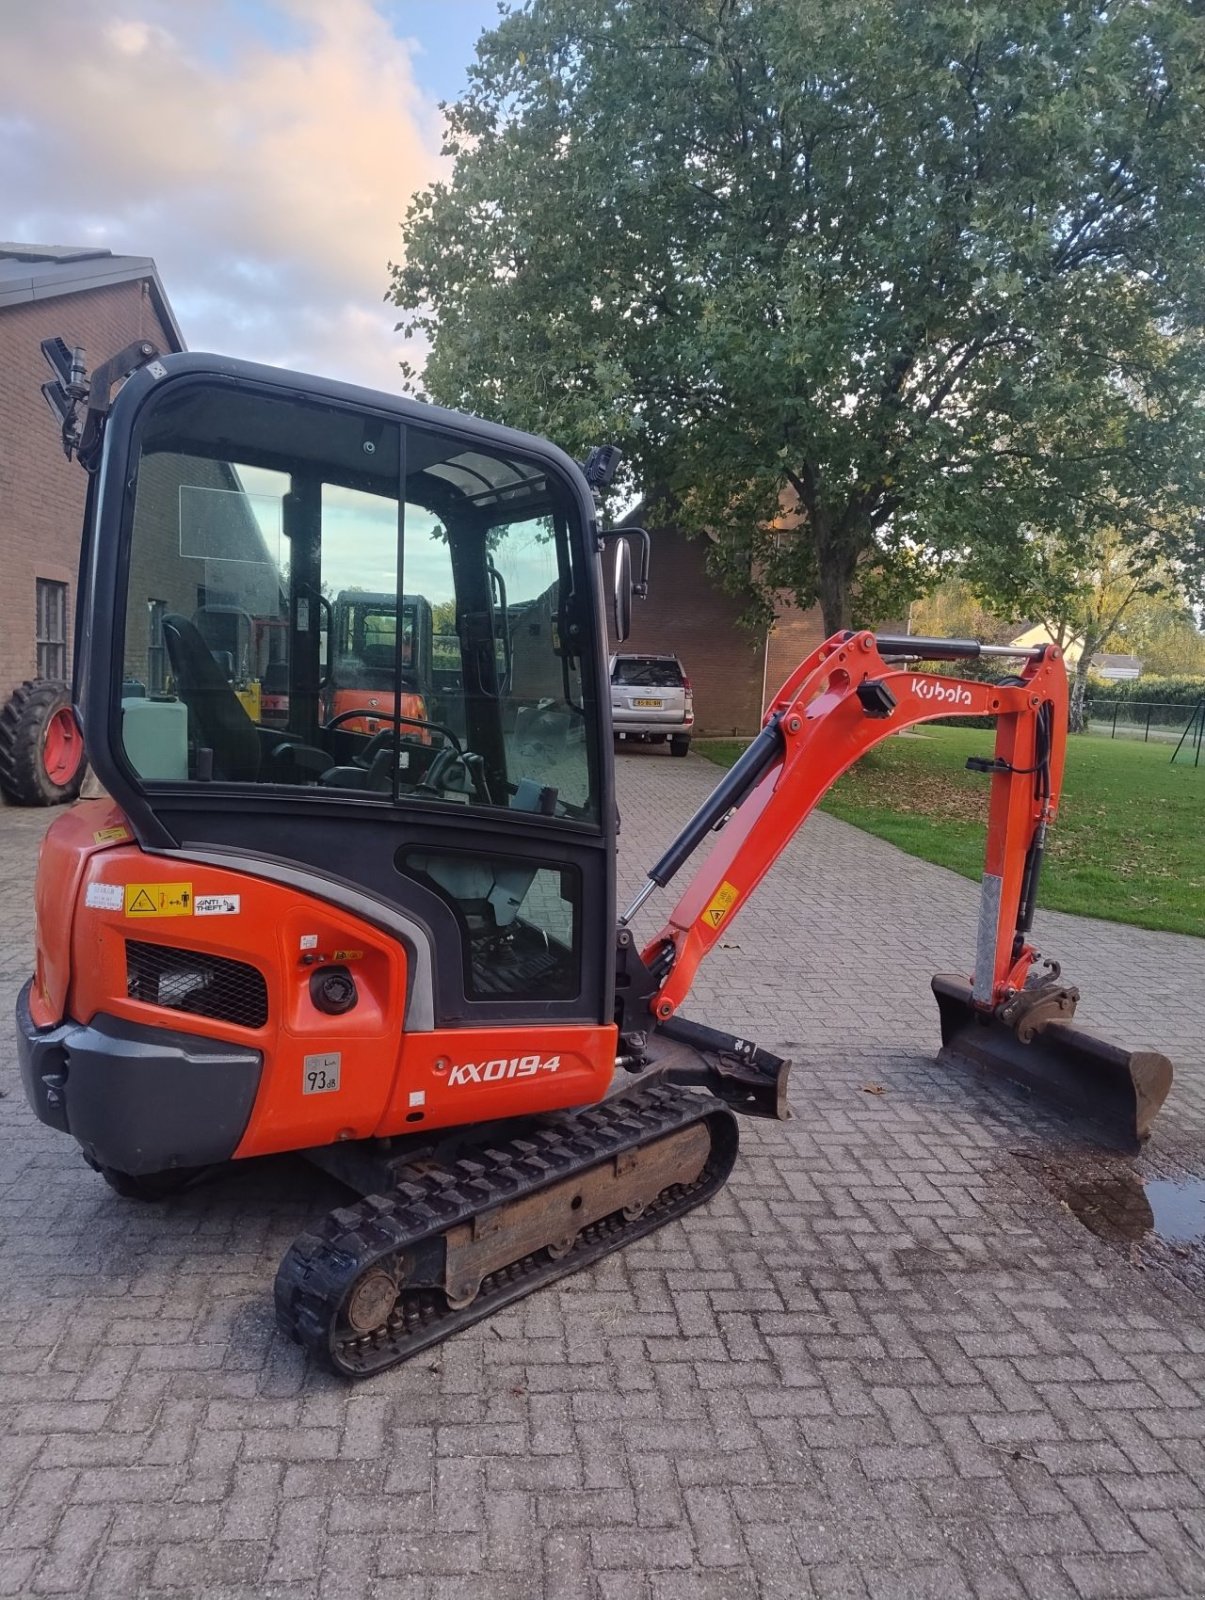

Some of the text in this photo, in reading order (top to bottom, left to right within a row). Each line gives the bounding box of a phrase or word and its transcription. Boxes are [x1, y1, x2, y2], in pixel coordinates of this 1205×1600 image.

[911, 678, 972, 705] Kubota
[196, 904, 223, 912] THEFT
[307, 1070, 336, 1091] 93 dB
[447, 1055, 561, 1087] KX019-4
